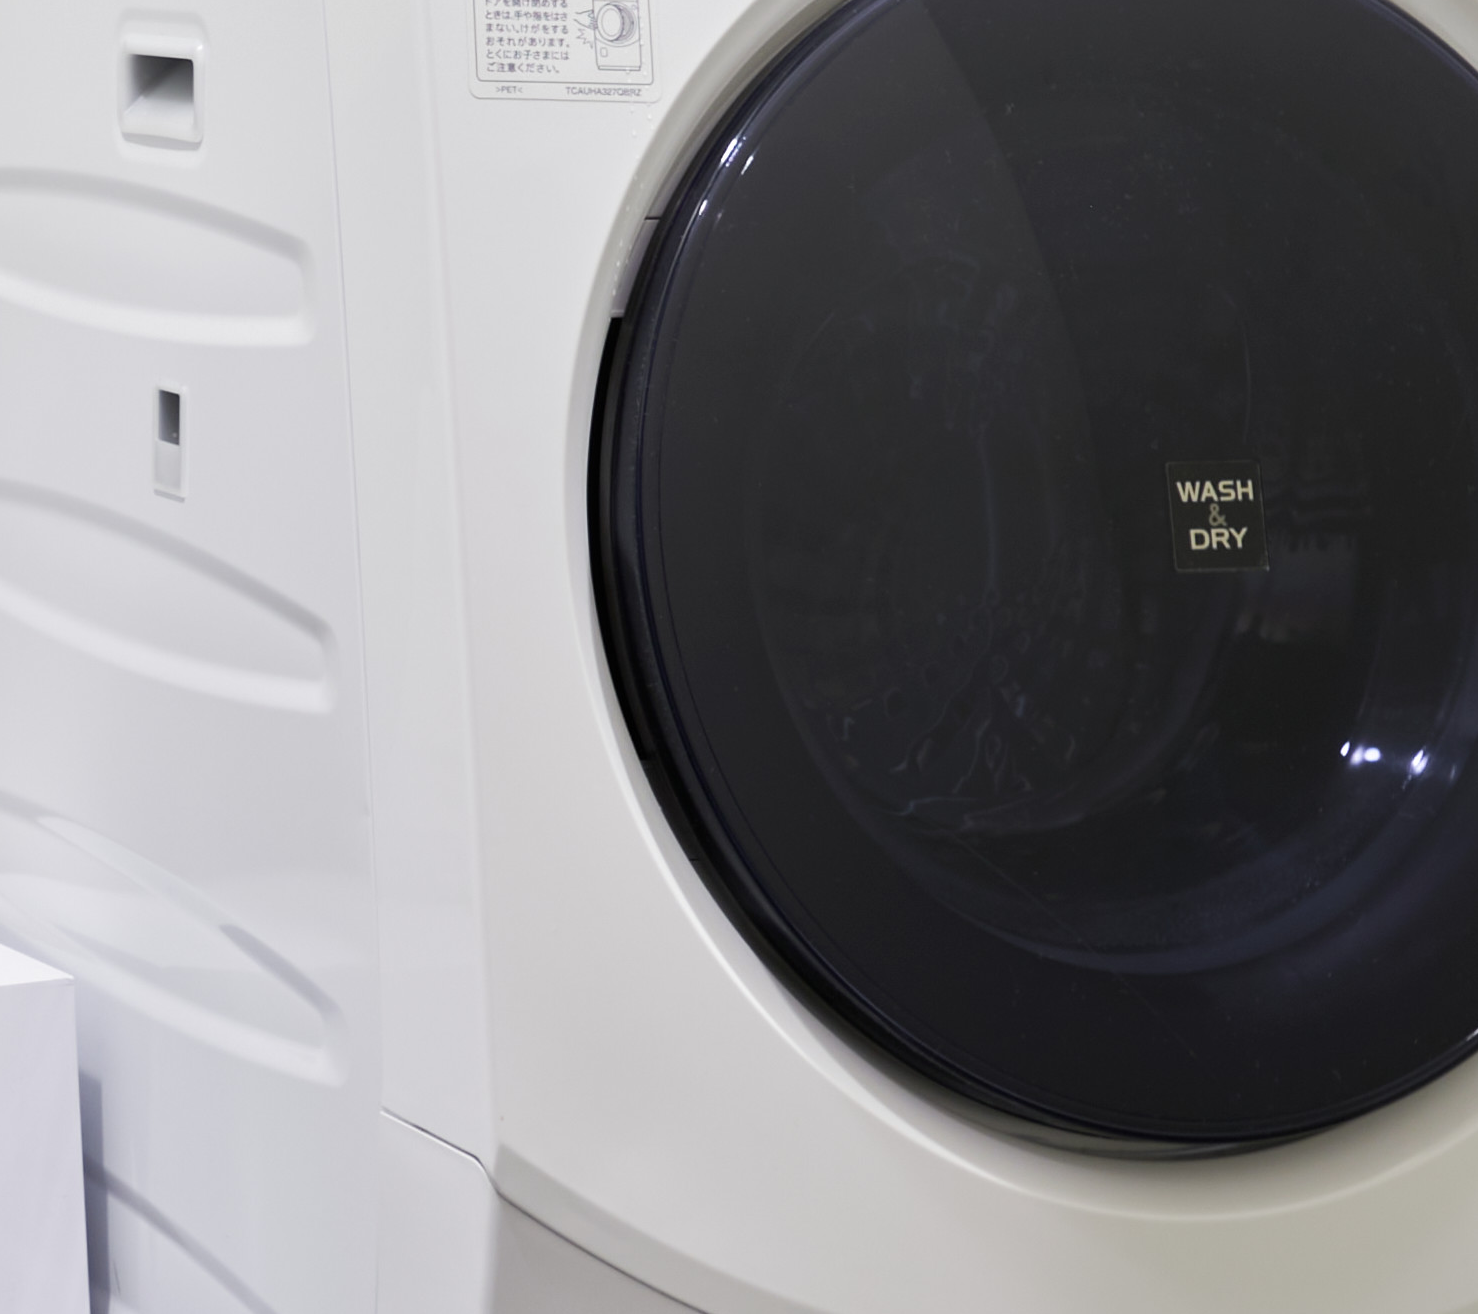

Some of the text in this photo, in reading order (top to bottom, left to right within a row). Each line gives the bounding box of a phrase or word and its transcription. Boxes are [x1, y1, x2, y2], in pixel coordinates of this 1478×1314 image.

[1176, 479, 1254, 502] WASH
[1209, 503, 1227, 526] &
[1190, 527, 1247, 550] DRY
